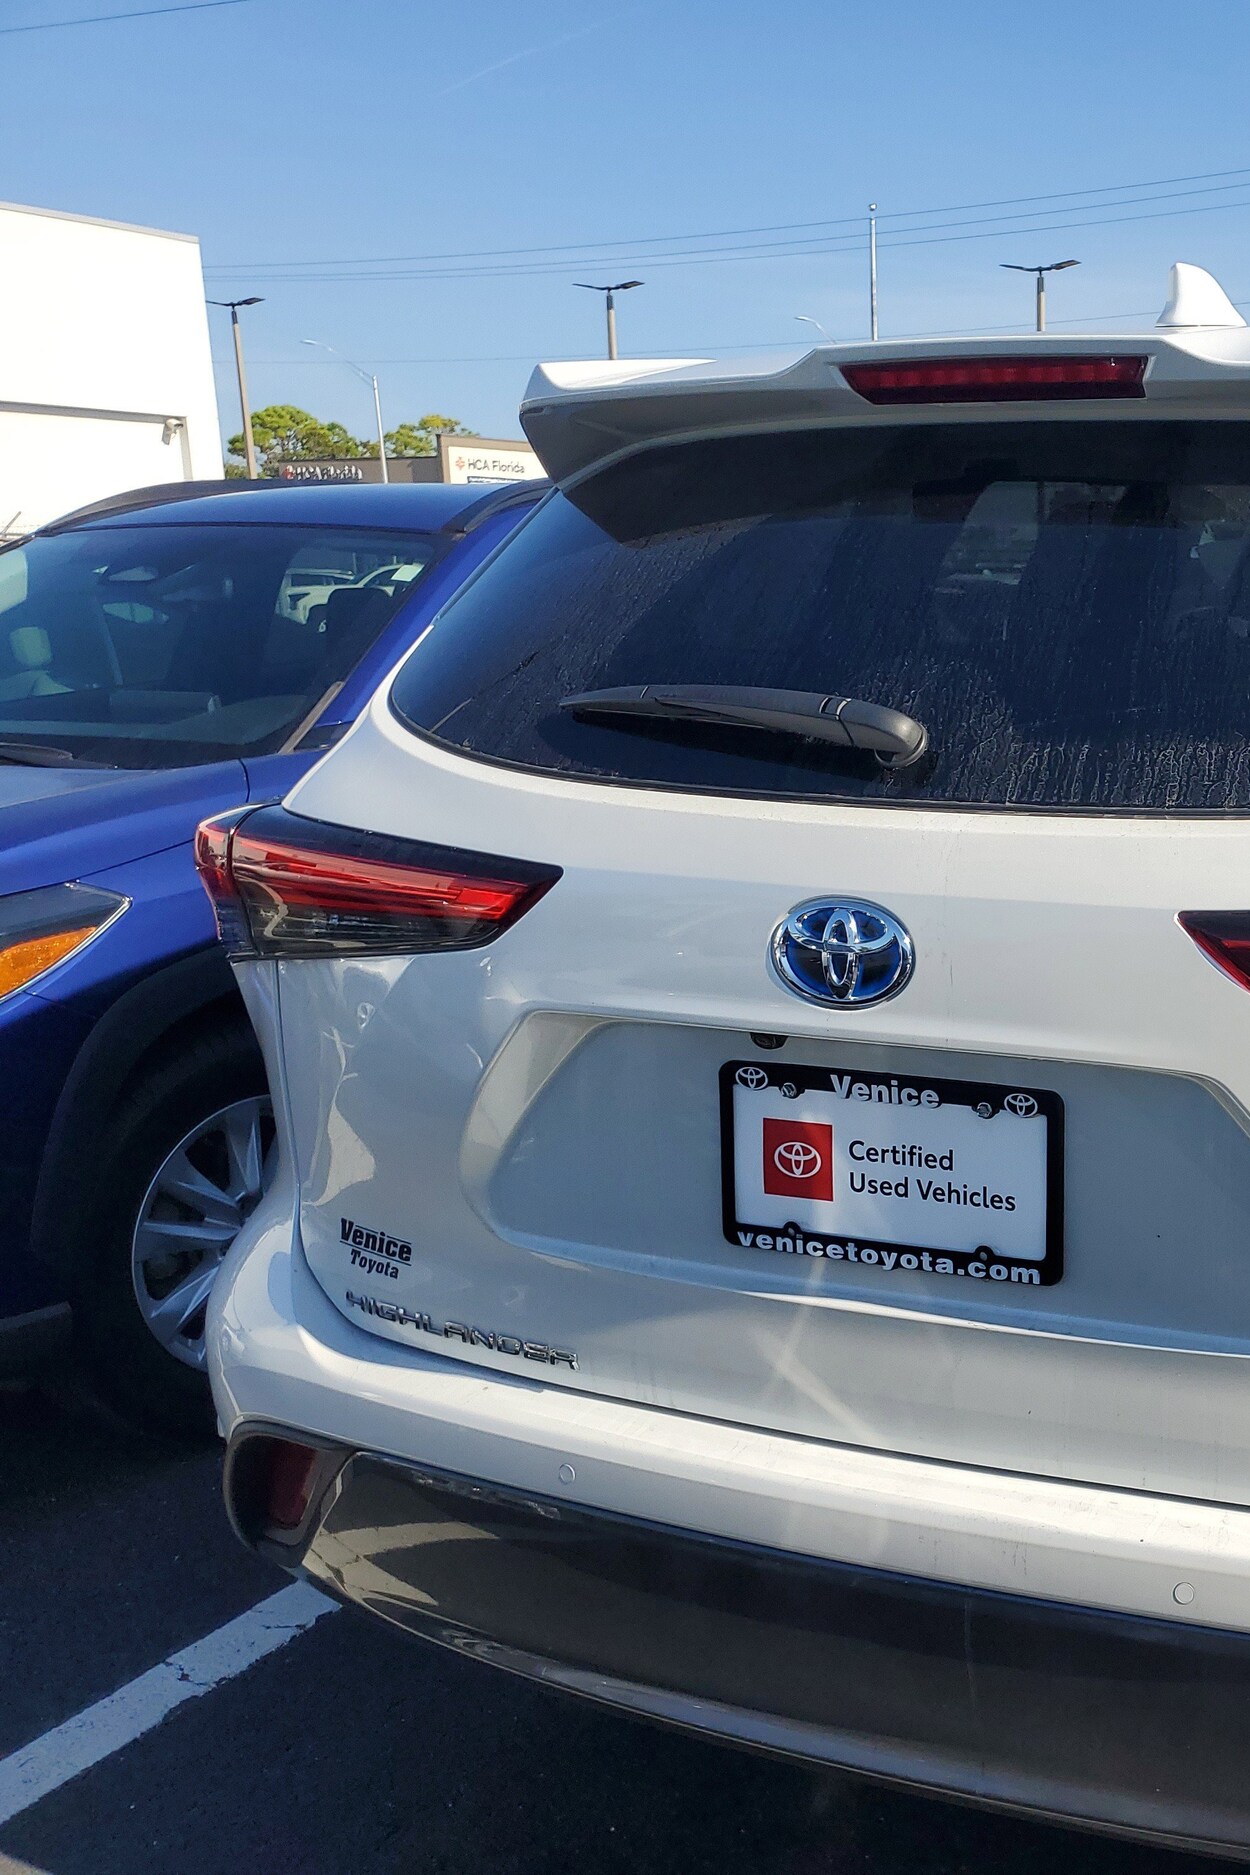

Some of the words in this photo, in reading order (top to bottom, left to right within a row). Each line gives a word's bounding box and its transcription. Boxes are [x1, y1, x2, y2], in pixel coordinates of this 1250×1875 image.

[468, 458, 489, 471] HCA
[492, 459, 525, 474] Florida
[830, 1073, 940, 1109] Venice
[849, 1140, 954, 1172] Certified
[849, 1172, 910, 1199] Used
[916, 1178, 1017, 1212] Vehicles
[340, 1217, 412, 1263] Venice
[736, 1230, 1041, 1286] venicetoyota.com
[350, 1249, 400, 1279] Toyota
[345, 1290, 581, 1371] HIGHLANDER
